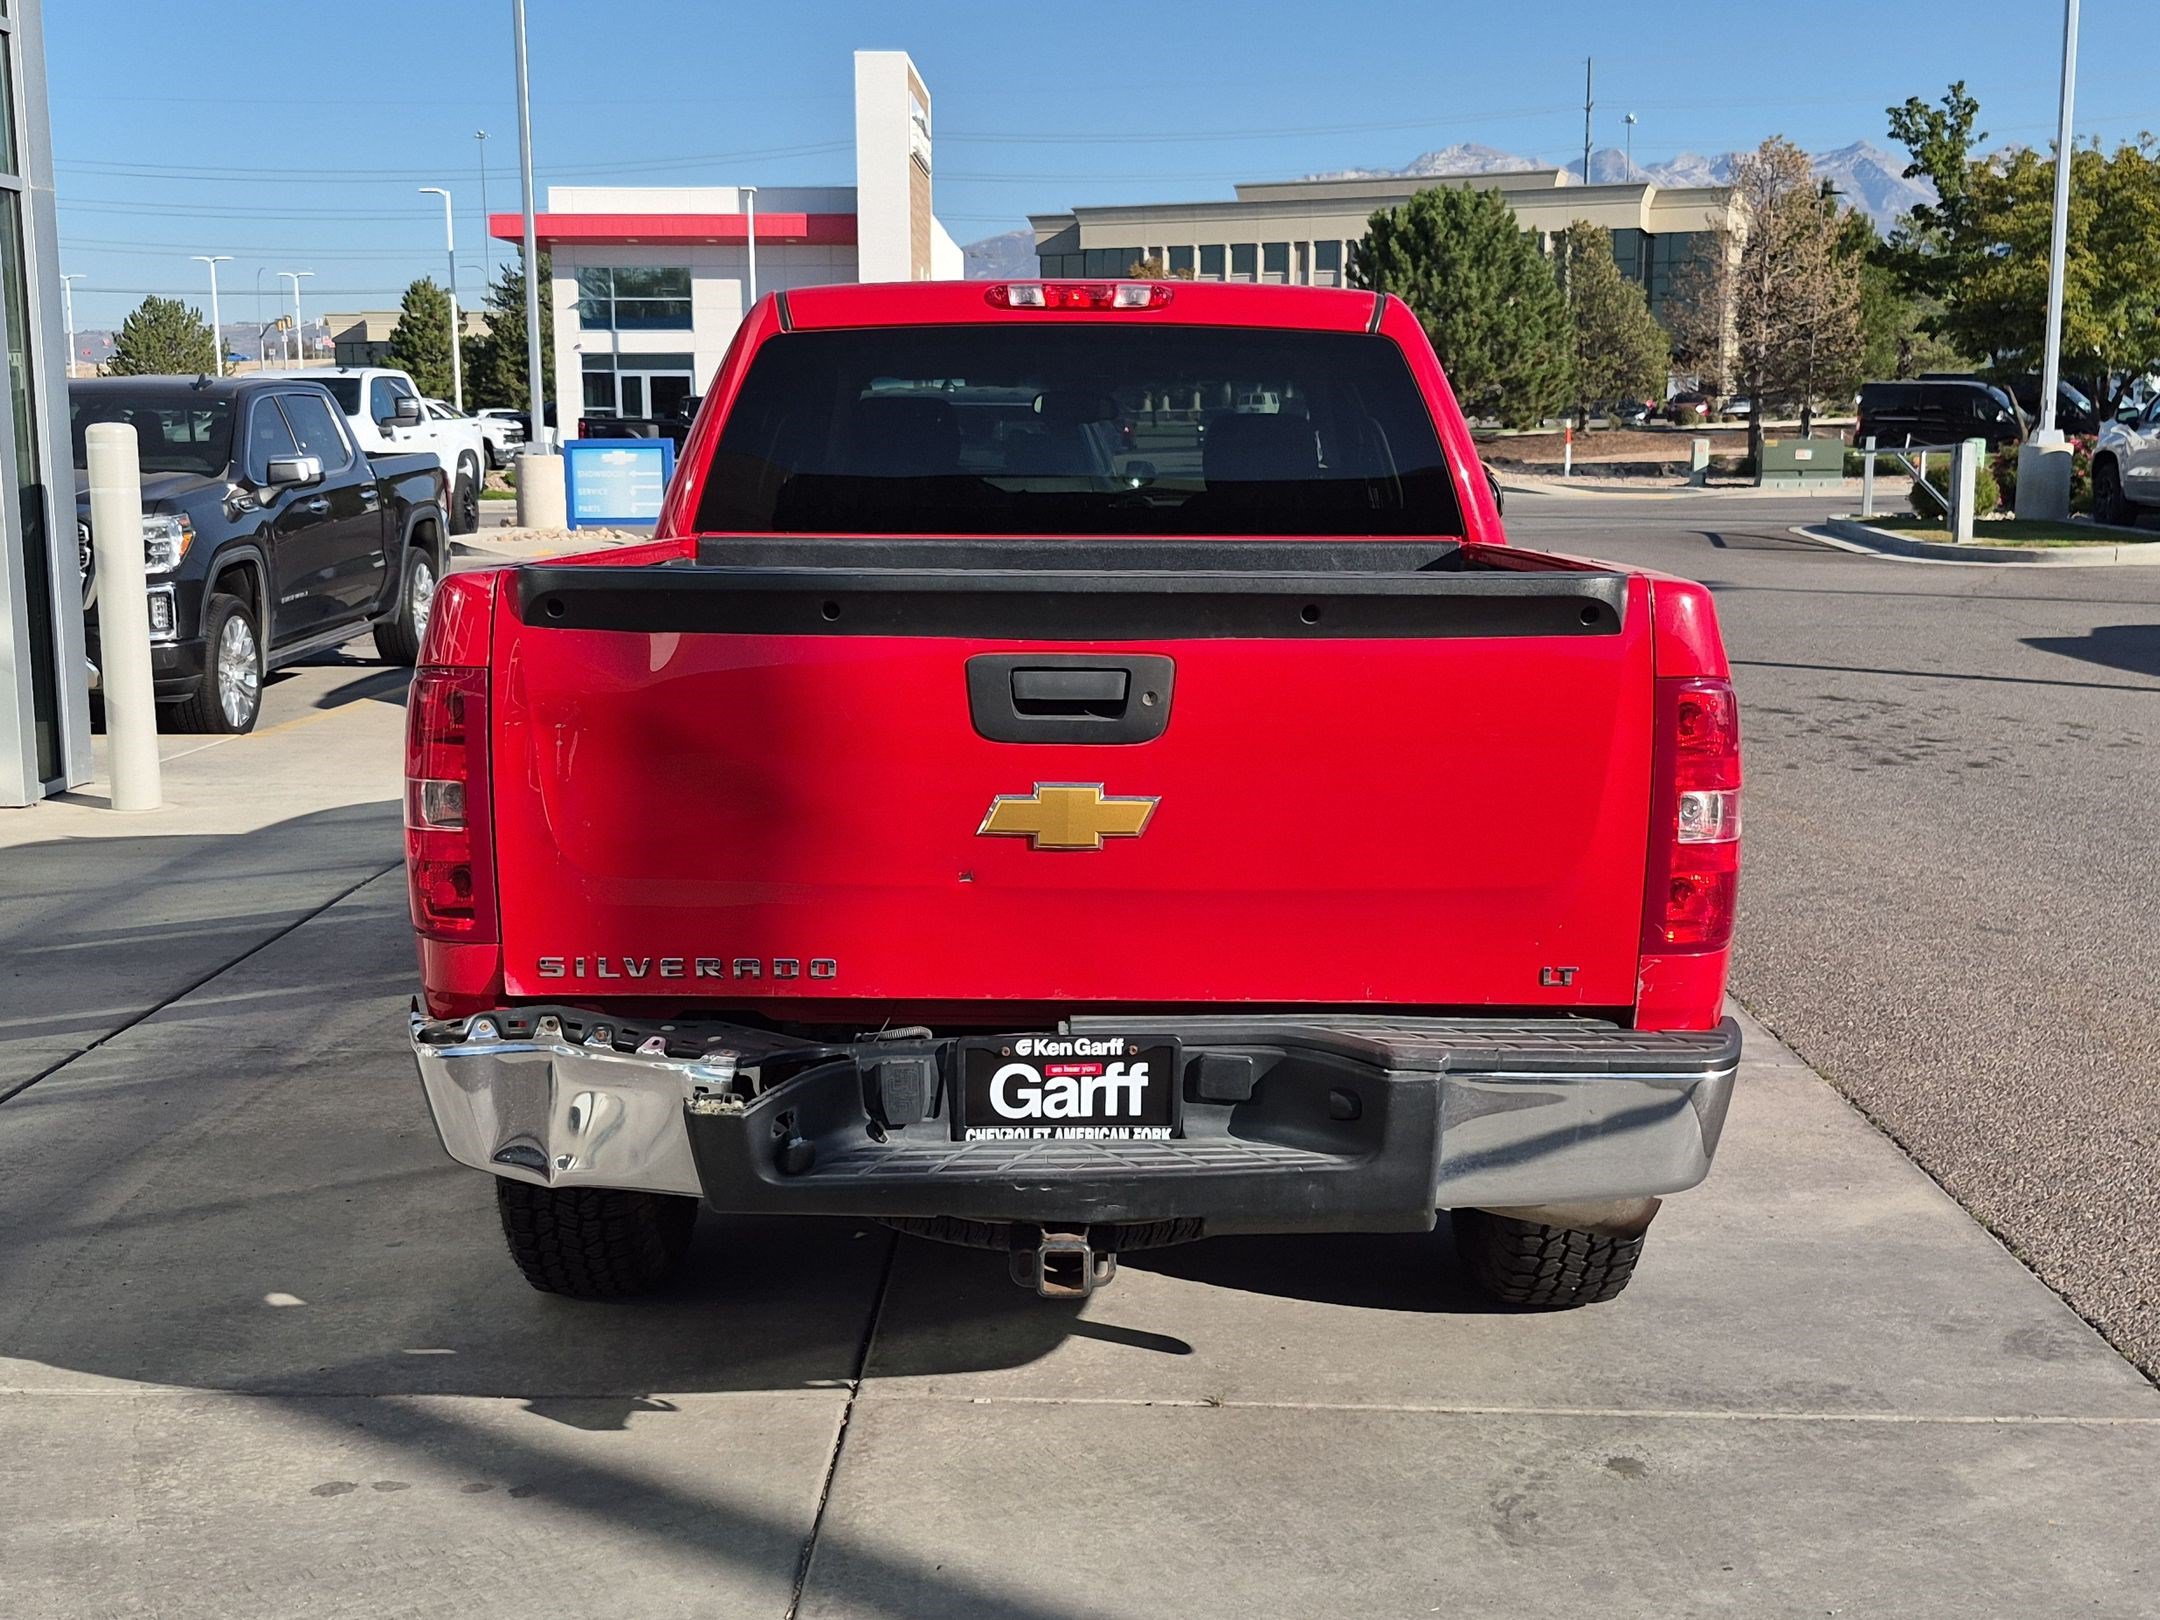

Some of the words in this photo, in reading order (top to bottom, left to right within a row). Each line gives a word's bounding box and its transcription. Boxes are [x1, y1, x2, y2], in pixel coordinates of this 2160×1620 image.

[538, 957, 837, 979] SILVERADO
[1542, 966, 1580, 986] LT
[1034, 1038, 1072, 1057] Ken
[1074, 1038, 1124, 1056] Garff
[1063, 1065, 1081, 1073] hear
[1081, 1066, 1097, 1074] you
[989, 1061, 1149, 1119] Garff
